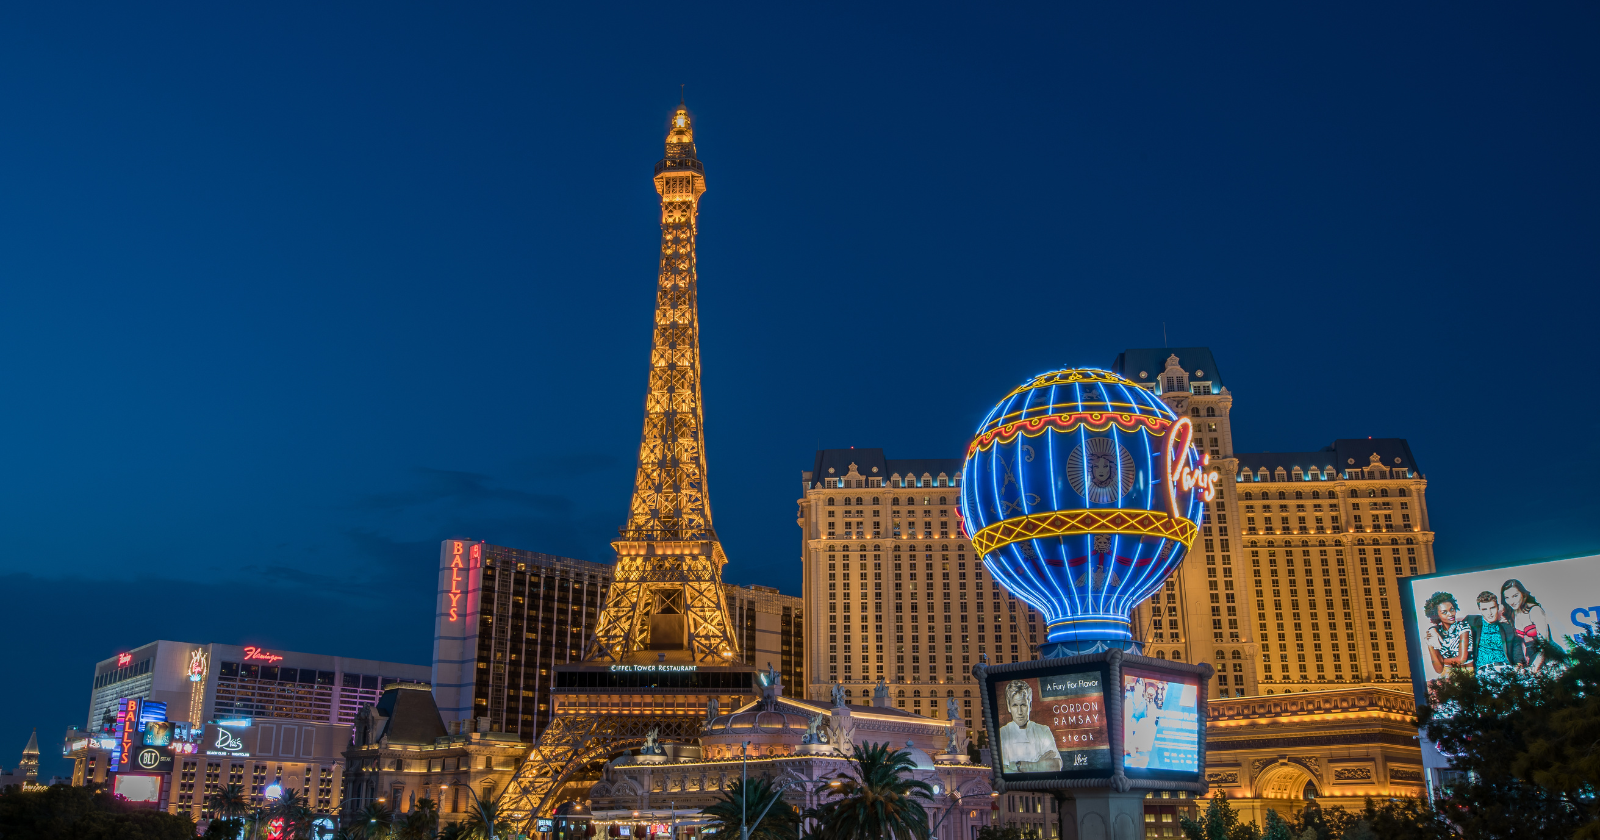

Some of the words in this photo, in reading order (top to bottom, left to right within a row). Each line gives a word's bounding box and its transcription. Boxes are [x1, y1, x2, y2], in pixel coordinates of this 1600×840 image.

[1167, 416, 1219, 519] Paris
[243, 646, 283, 663] Flamingo
[611, 664, 632, 672] EIFFEL
[633, 664, 656, 672] TOWER
[658, 664, 697, 672] RESTAURANT
[1046, 683, 1052, 691] A
[1052, 682, 1066, 691] Fury
[1066, 680, 1078, 689] For
[1078, 679, 1099, 688] Flavor
[1052, 701, 1099, 715] GORDON
[1053, 713, 1099, 726] RAMSAY
[1062, 732, 1094, 743] steak
[143, 752, 156, 765] BLT
